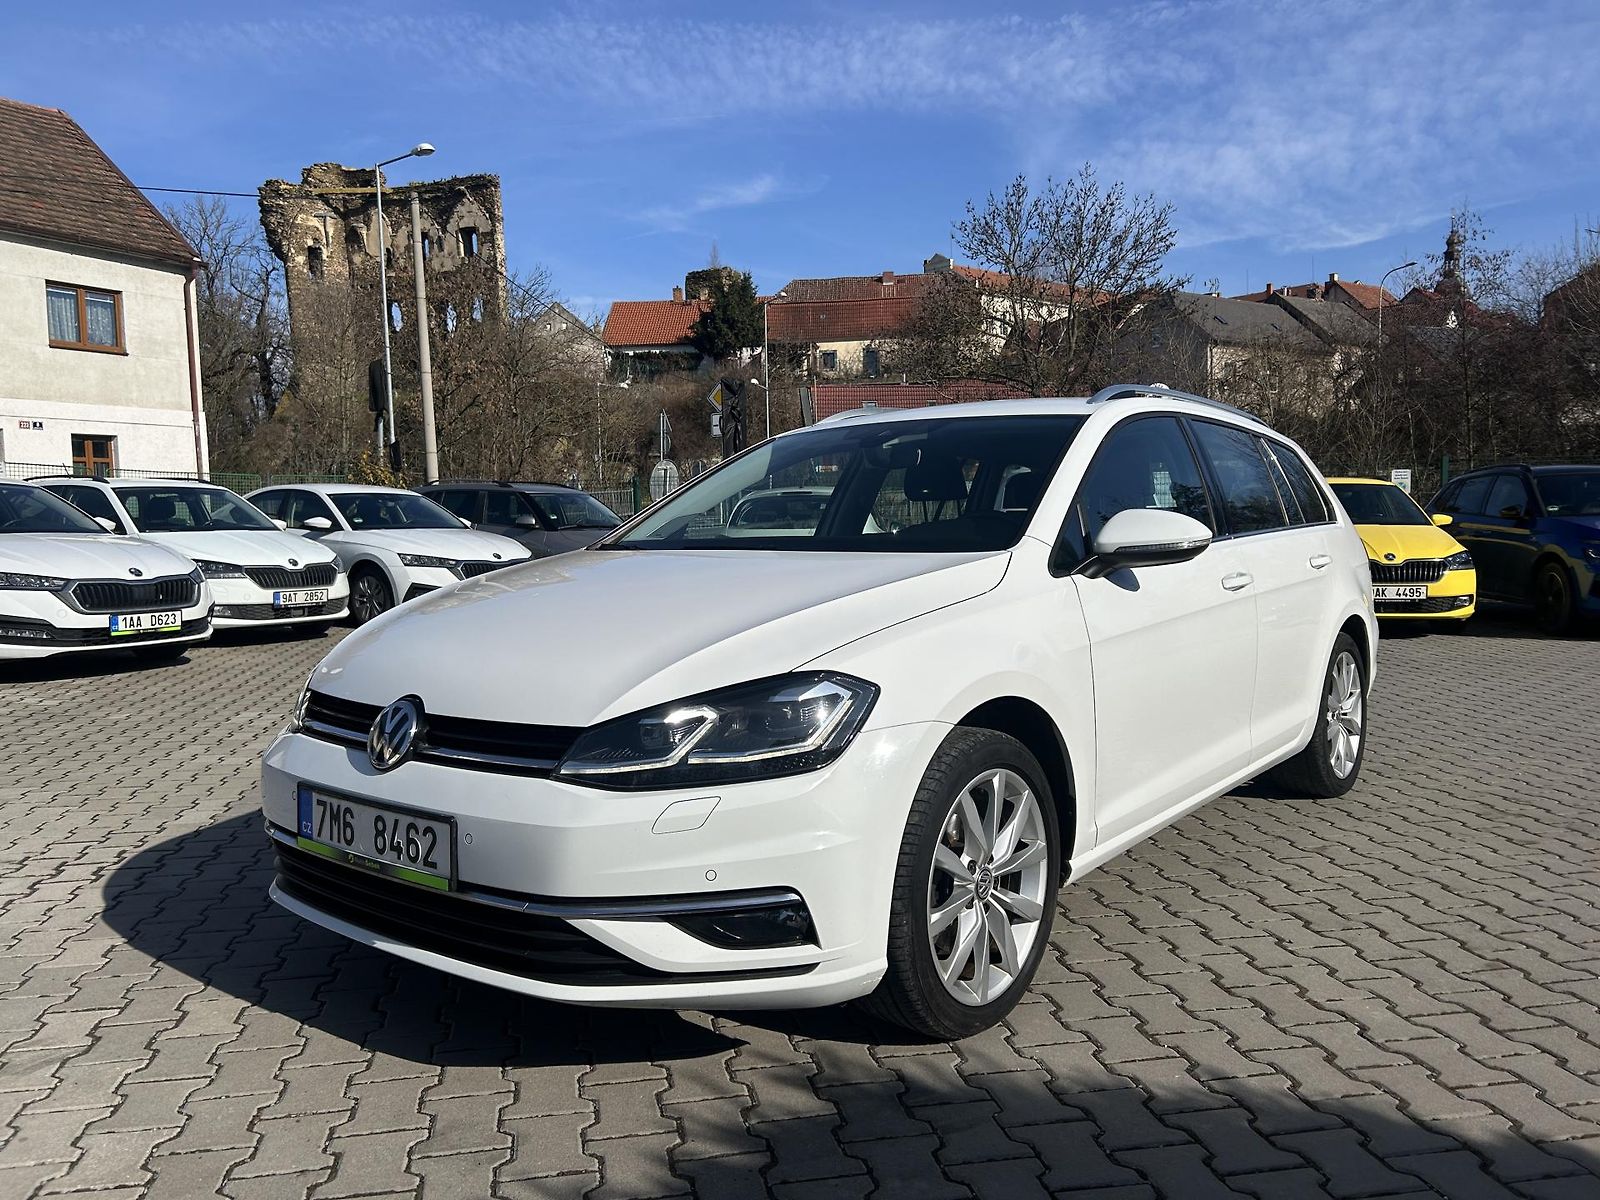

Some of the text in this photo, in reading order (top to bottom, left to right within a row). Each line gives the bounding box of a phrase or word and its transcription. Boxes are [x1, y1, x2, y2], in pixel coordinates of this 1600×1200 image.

[282, 592, 298, 603] 9AT
[304, 591, 324, 602] 2852
[1372, 587, 1422, 598] AK 4495
[121, 612, 177, 629] 1AA D623
[302, 821, 312, 834] CZ
[316, 798, 438, 870] 7M6 8462
